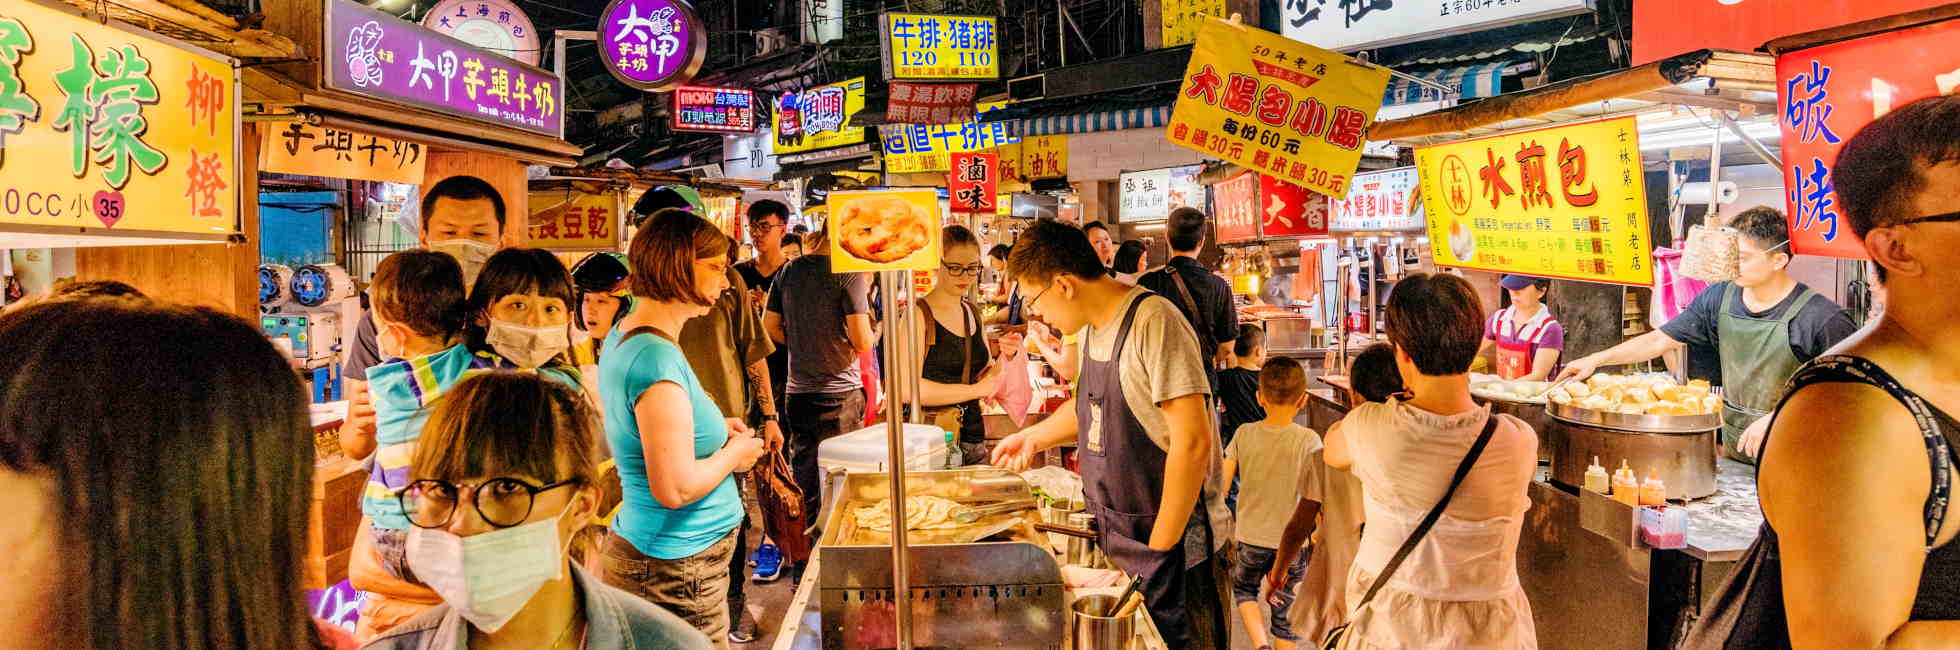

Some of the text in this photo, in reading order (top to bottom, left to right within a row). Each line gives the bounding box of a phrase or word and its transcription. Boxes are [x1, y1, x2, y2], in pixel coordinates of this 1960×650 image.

[439, 2, 526, 39] 大上海煎包
[613, 2, 680, 74] 大甲
[901, 50, 991, 66] 120 110
[1252, 45, 1327, 75] 50年老店
[1186, 65, 1367, 150] 大腸包小腸
[184, 62, 227, 217] 柳橙
[750, 149, 764, 168] PD
[1785, 61, 1840, 242] 碳烤
[957, 155, 990, 210] 滷味
[1447, 160, 1467, 209] 士林
[1479, 137, 1599, 211] 水煎包
[71, 192, 90, 218] 小
[99, 198, 120, 218] 35
